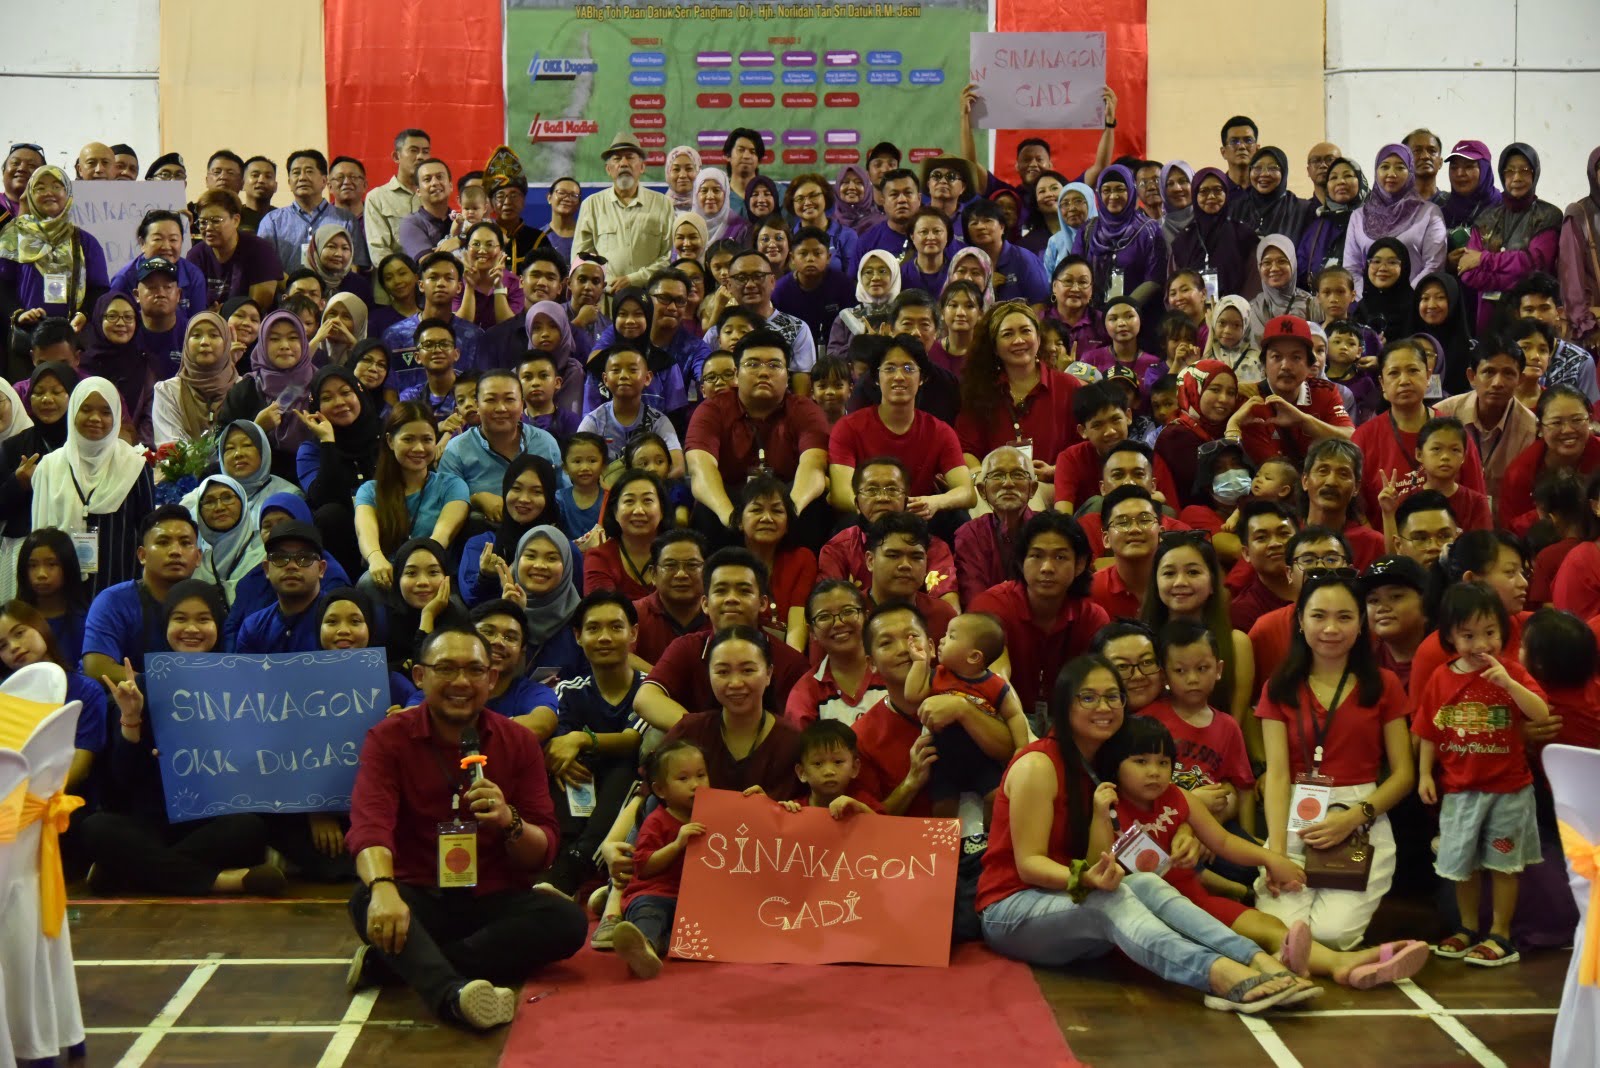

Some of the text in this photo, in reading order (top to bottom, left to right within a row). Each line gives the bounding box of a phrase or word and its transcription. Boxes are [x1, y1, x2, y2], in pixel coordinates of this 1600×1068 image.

[575, 5, 604, 21] YABhg
[605, 5, 622, 18] Toh
[623, 5, 646, 18] Puan
[647, 5, 673, 18] Datuk
[675, 5, 692, 18] Seri
[694, 5, 733, 21] Panglima
[778, 4, 814, 18] Norlidah
[815, 4, 832, 18] Tan
[833, 4, 846, 17] Sri
[848, 4, 873, 17] Datuk
[897, 4, 921, 17] Jasni
[994, 48, 1106, 69] SINAKAGON
[1015, 80, 1074, 107] GADI
[171, 688, 381, 723] SINAKAGON
[172, 741, 359, 777] OKK DUGAS
[700, 823, 937, 881] SINAKAGON
[757, 890, 863, 930] GADI
